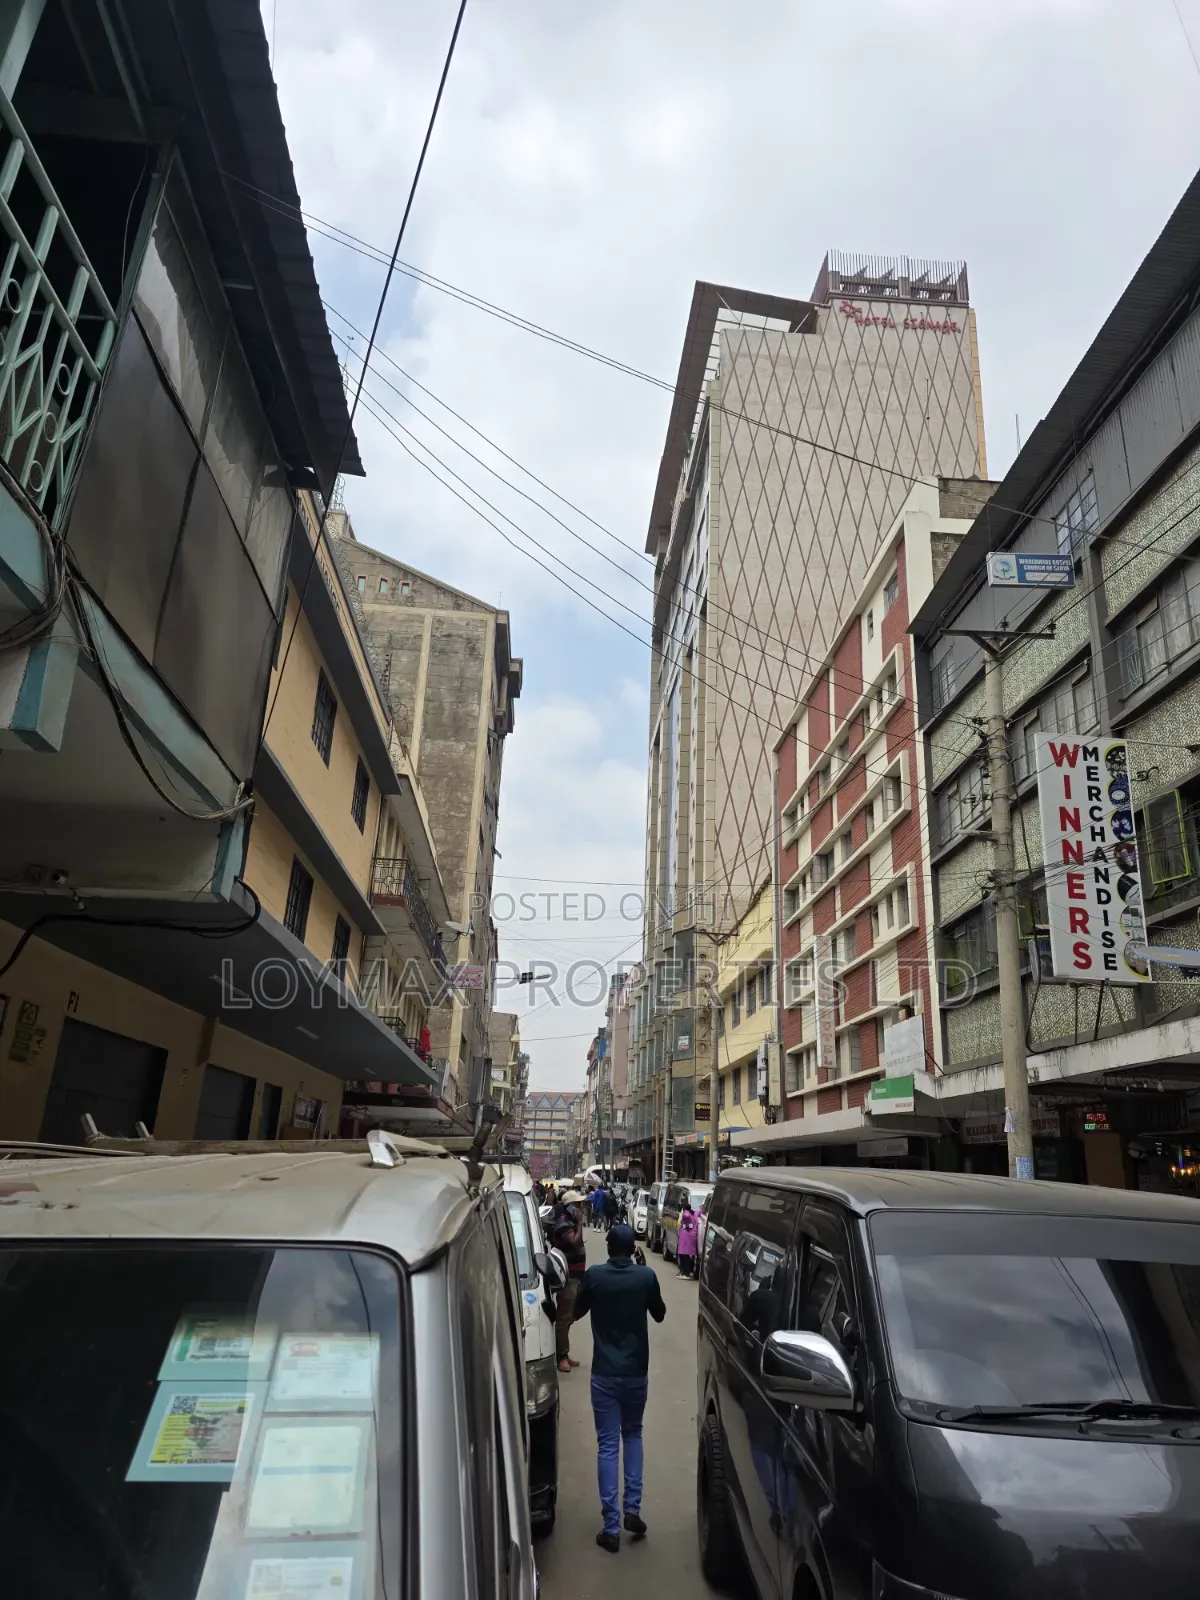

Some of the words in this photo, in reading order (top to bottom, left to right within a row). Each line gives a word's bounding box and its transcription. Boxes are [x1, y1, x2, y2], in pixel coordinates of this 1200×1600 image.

[855, 316, 896, 328] HOTEL
[1048, 741, 1093, 971] WINNERS
[1082, 745, 1118, 971] MERCHANDISE
